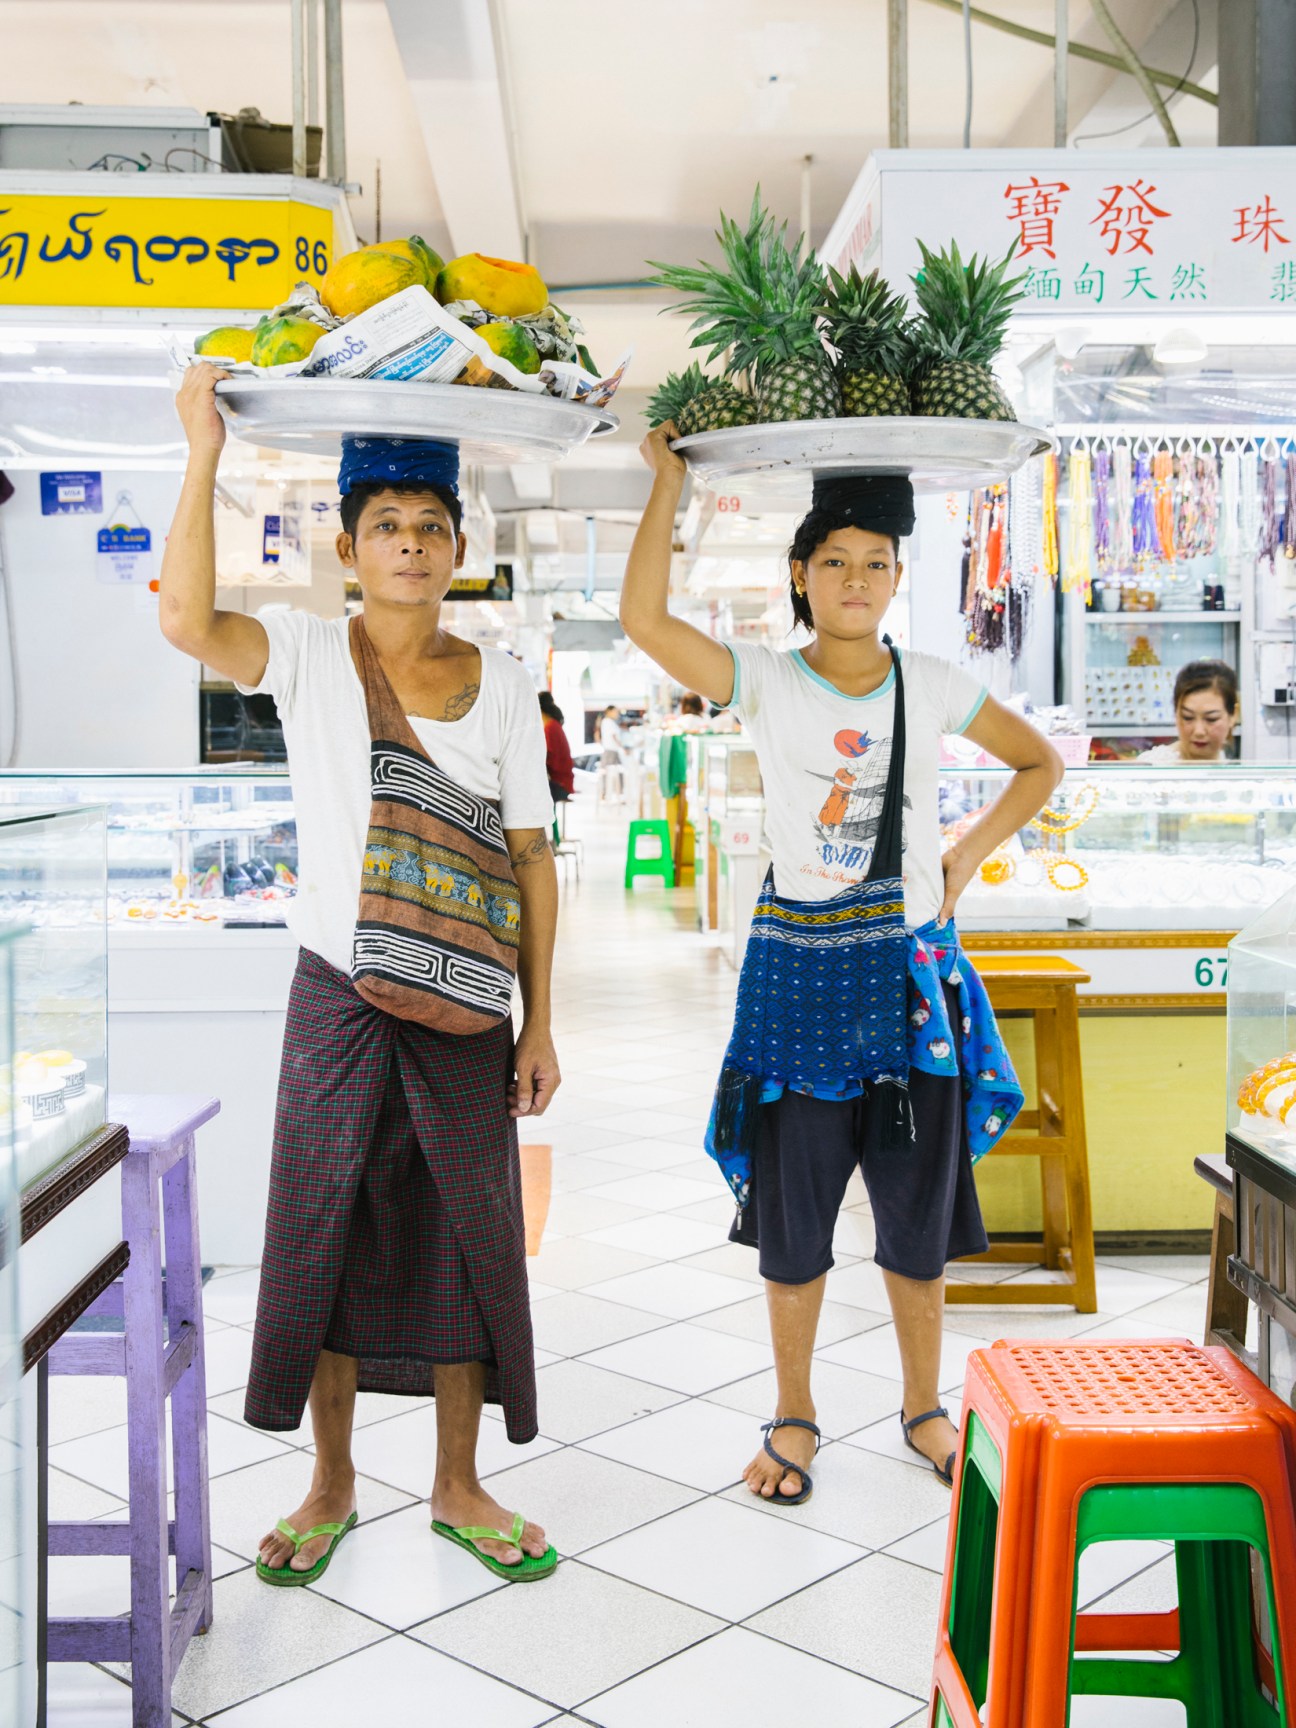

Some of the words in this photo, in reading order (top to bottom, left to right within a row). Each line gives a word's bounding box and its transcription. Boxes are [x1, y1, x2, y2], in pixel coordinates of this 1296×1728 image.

[1231, 194, 1291, 253] 珠
[295, 236, 328, 276] 86
[717, 496, 741, 512] 69
[733, 832, 750, 844] 69
[1195, 957, 1228, 987] 67
